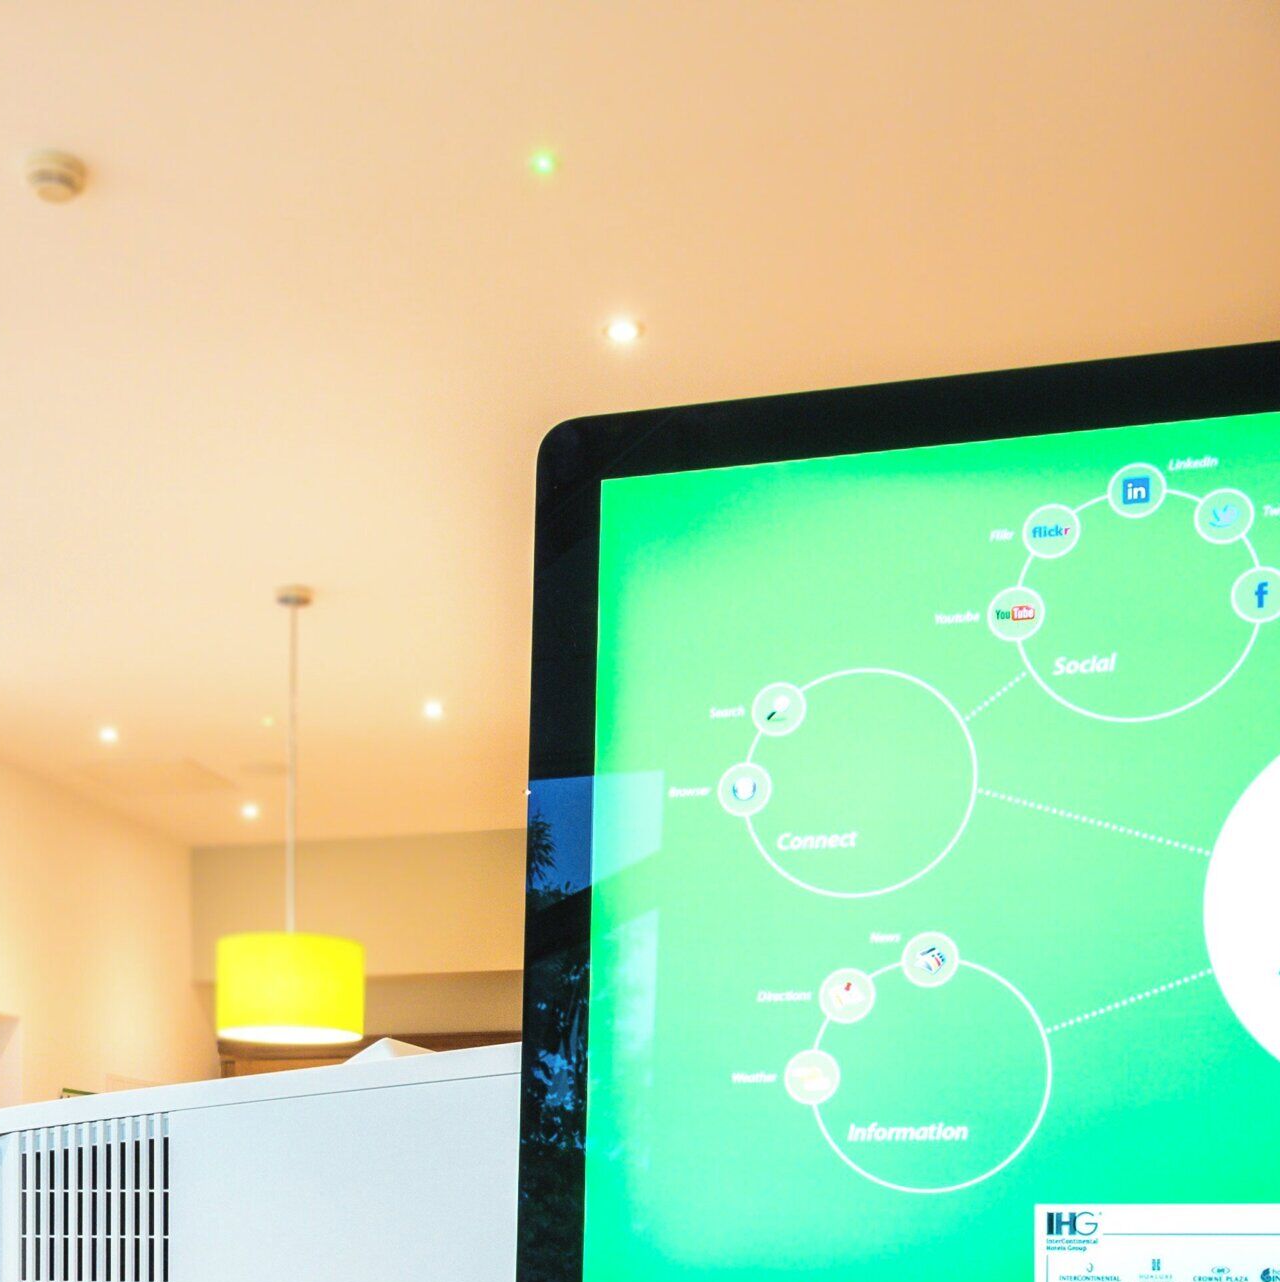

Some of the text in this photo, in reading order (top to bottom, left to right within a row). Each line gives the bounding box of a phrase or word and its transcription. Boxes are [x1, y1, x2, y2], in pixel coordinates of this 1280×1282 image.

[1127, 483, 1146, 500] in
[1031, 525, 1070, 538] flickr
[1254, 581, 1268, 608] f
[1052, 652, 1117, 676] Social
[710, 705, 745, 719] Search
[777, 832, 858, 851] Connect
[847, 1122, 968, 1142] Information
[1046, 1211, 1098, 1236] IHG
